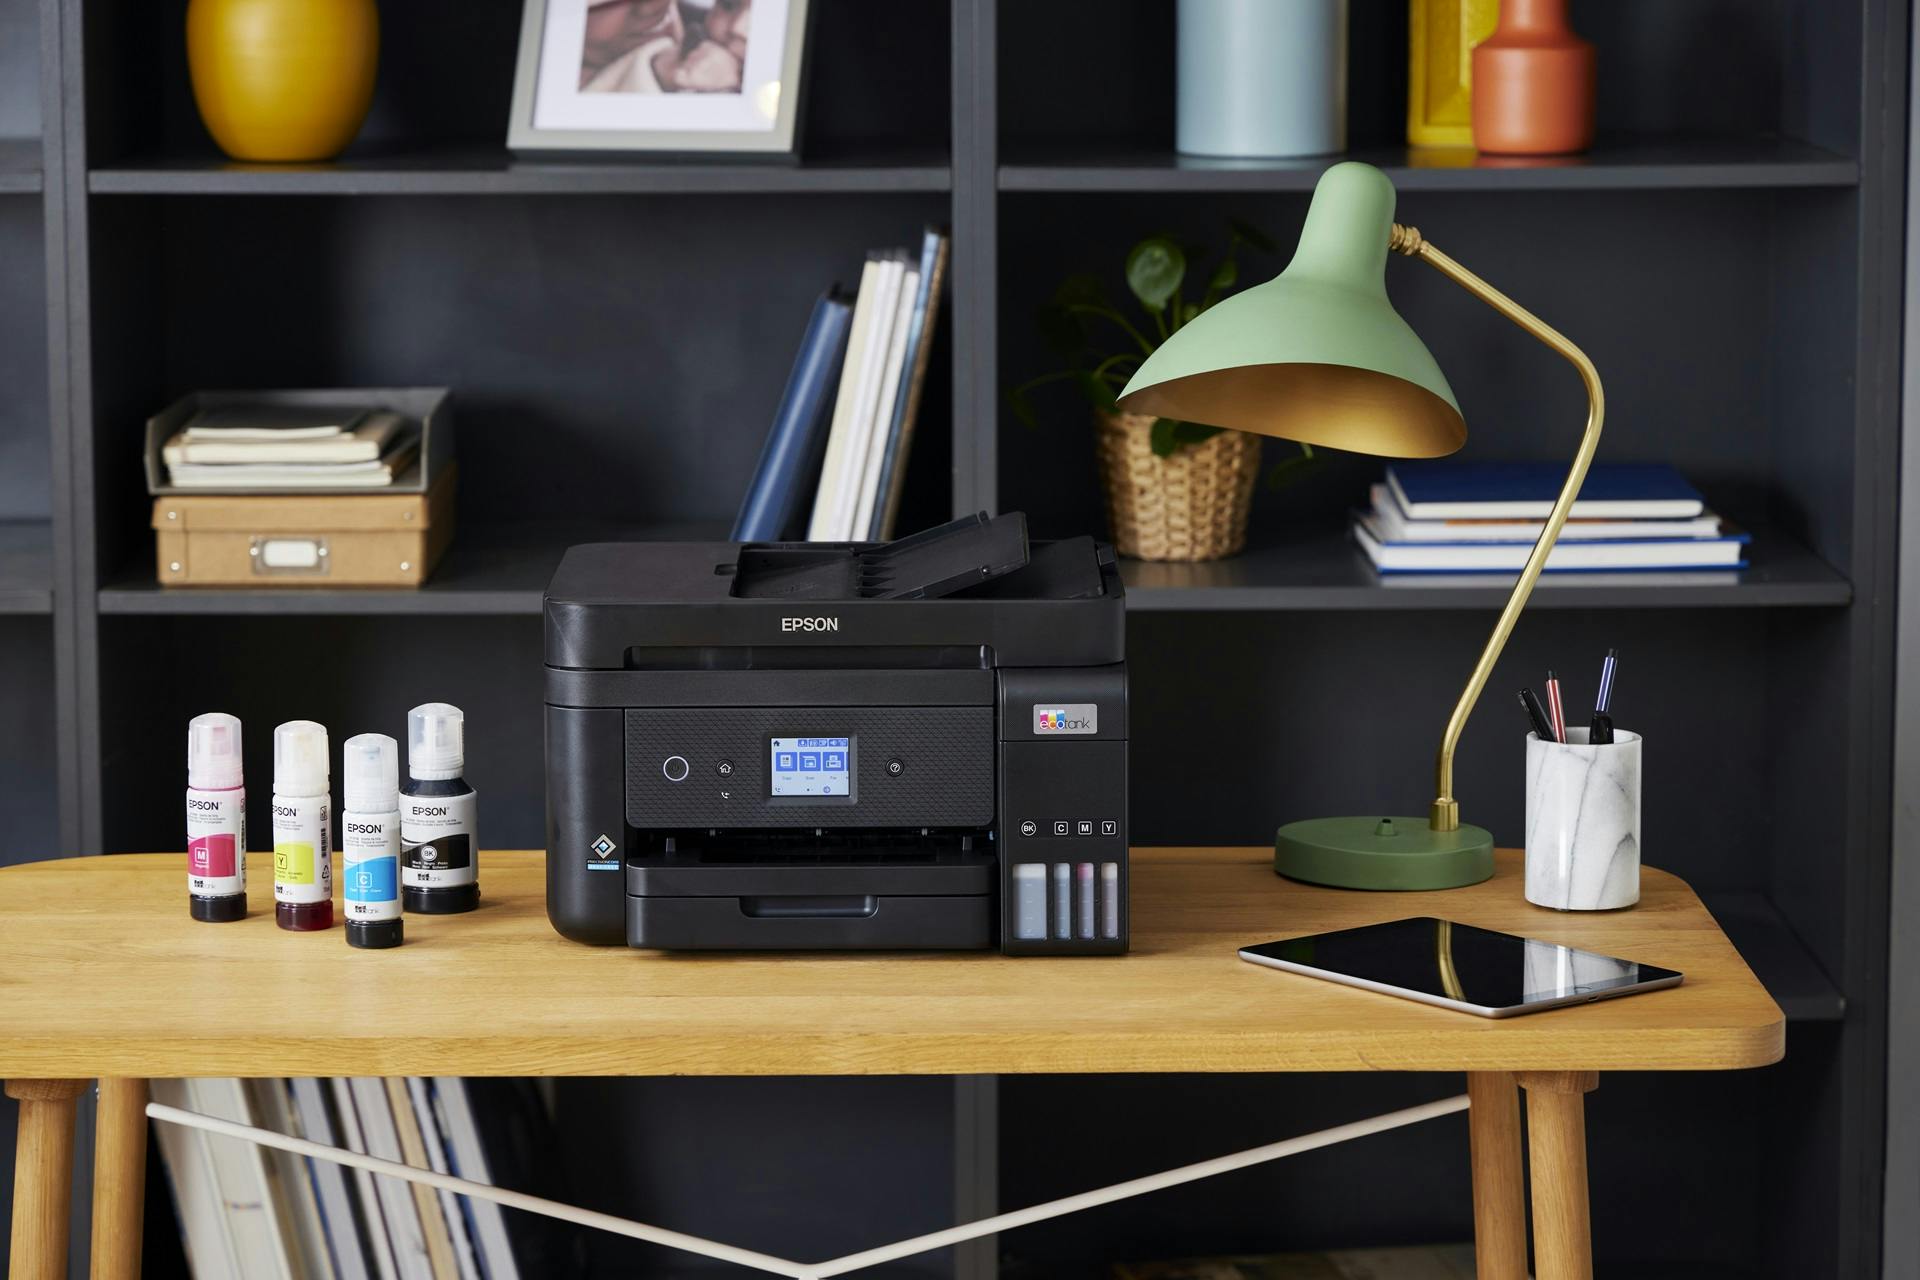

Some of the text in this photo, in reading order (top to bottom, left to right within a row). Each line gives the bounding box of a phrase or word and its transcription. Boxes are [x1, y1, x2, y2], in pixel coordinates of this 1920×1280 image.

[782, 617, 838, 631] EPSON
[1040, 716, 1090, 730] ecotank
[189, 799, 219, 811] EPSON
[412, 806, 447, 816] EPSON
[348, 823, 382, 834] EPSON
